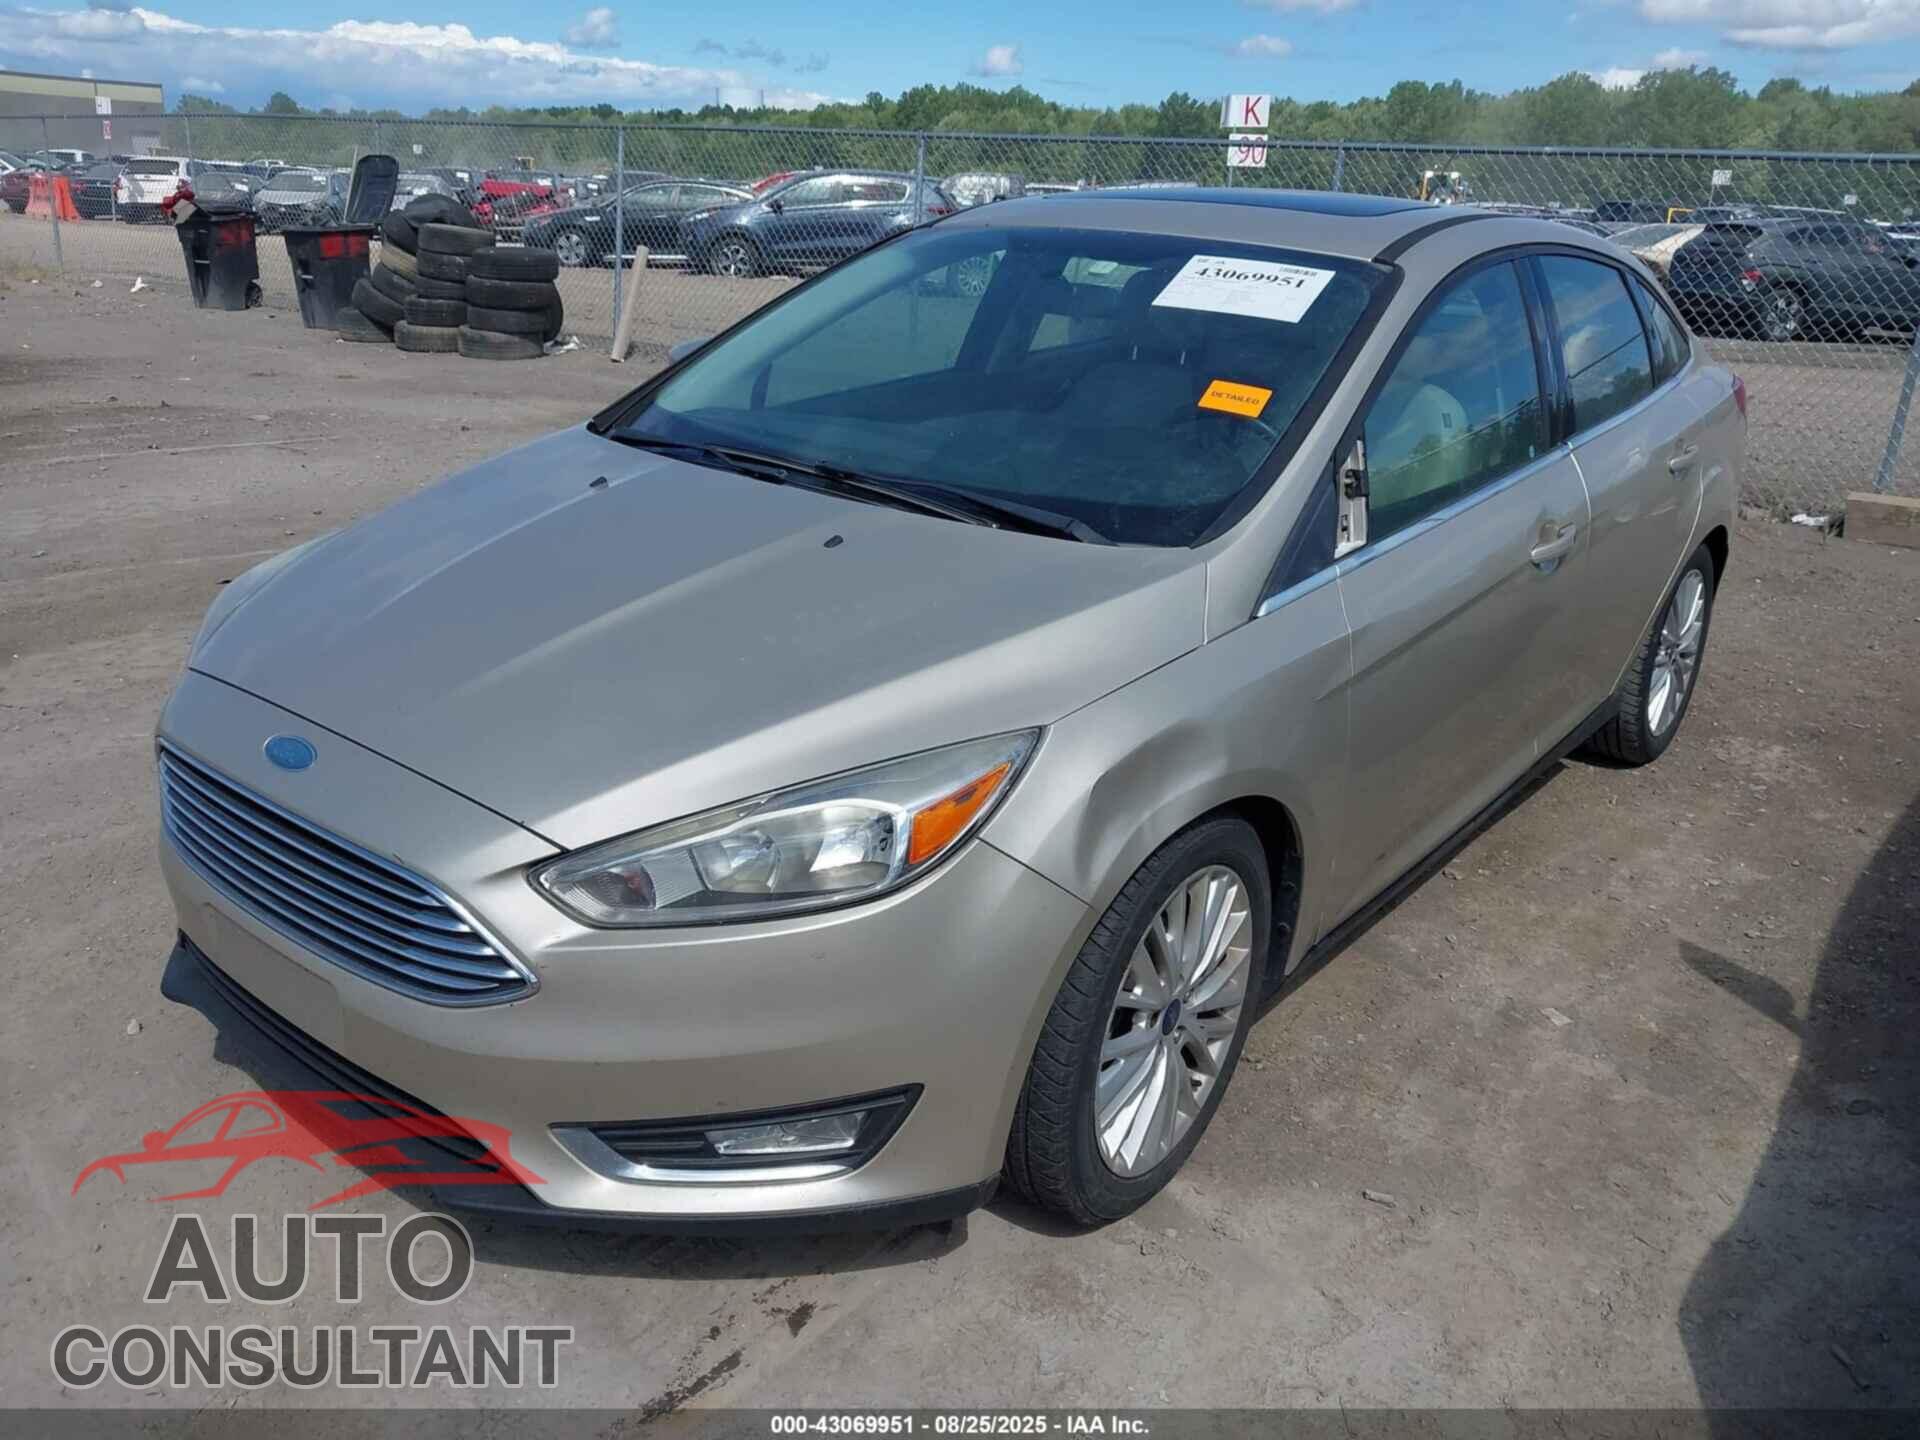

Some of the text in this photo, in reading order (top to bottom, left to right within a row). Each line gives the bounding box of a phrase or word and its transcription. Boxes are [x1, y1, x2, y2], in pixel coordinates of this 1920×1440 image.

[1244, 96, 1263, 125] K
[1238, 136, 1265, 165] 90
[1195, 267, 1306, 289] 43069951
[1210, 389, 1260, 406] DETAILED
